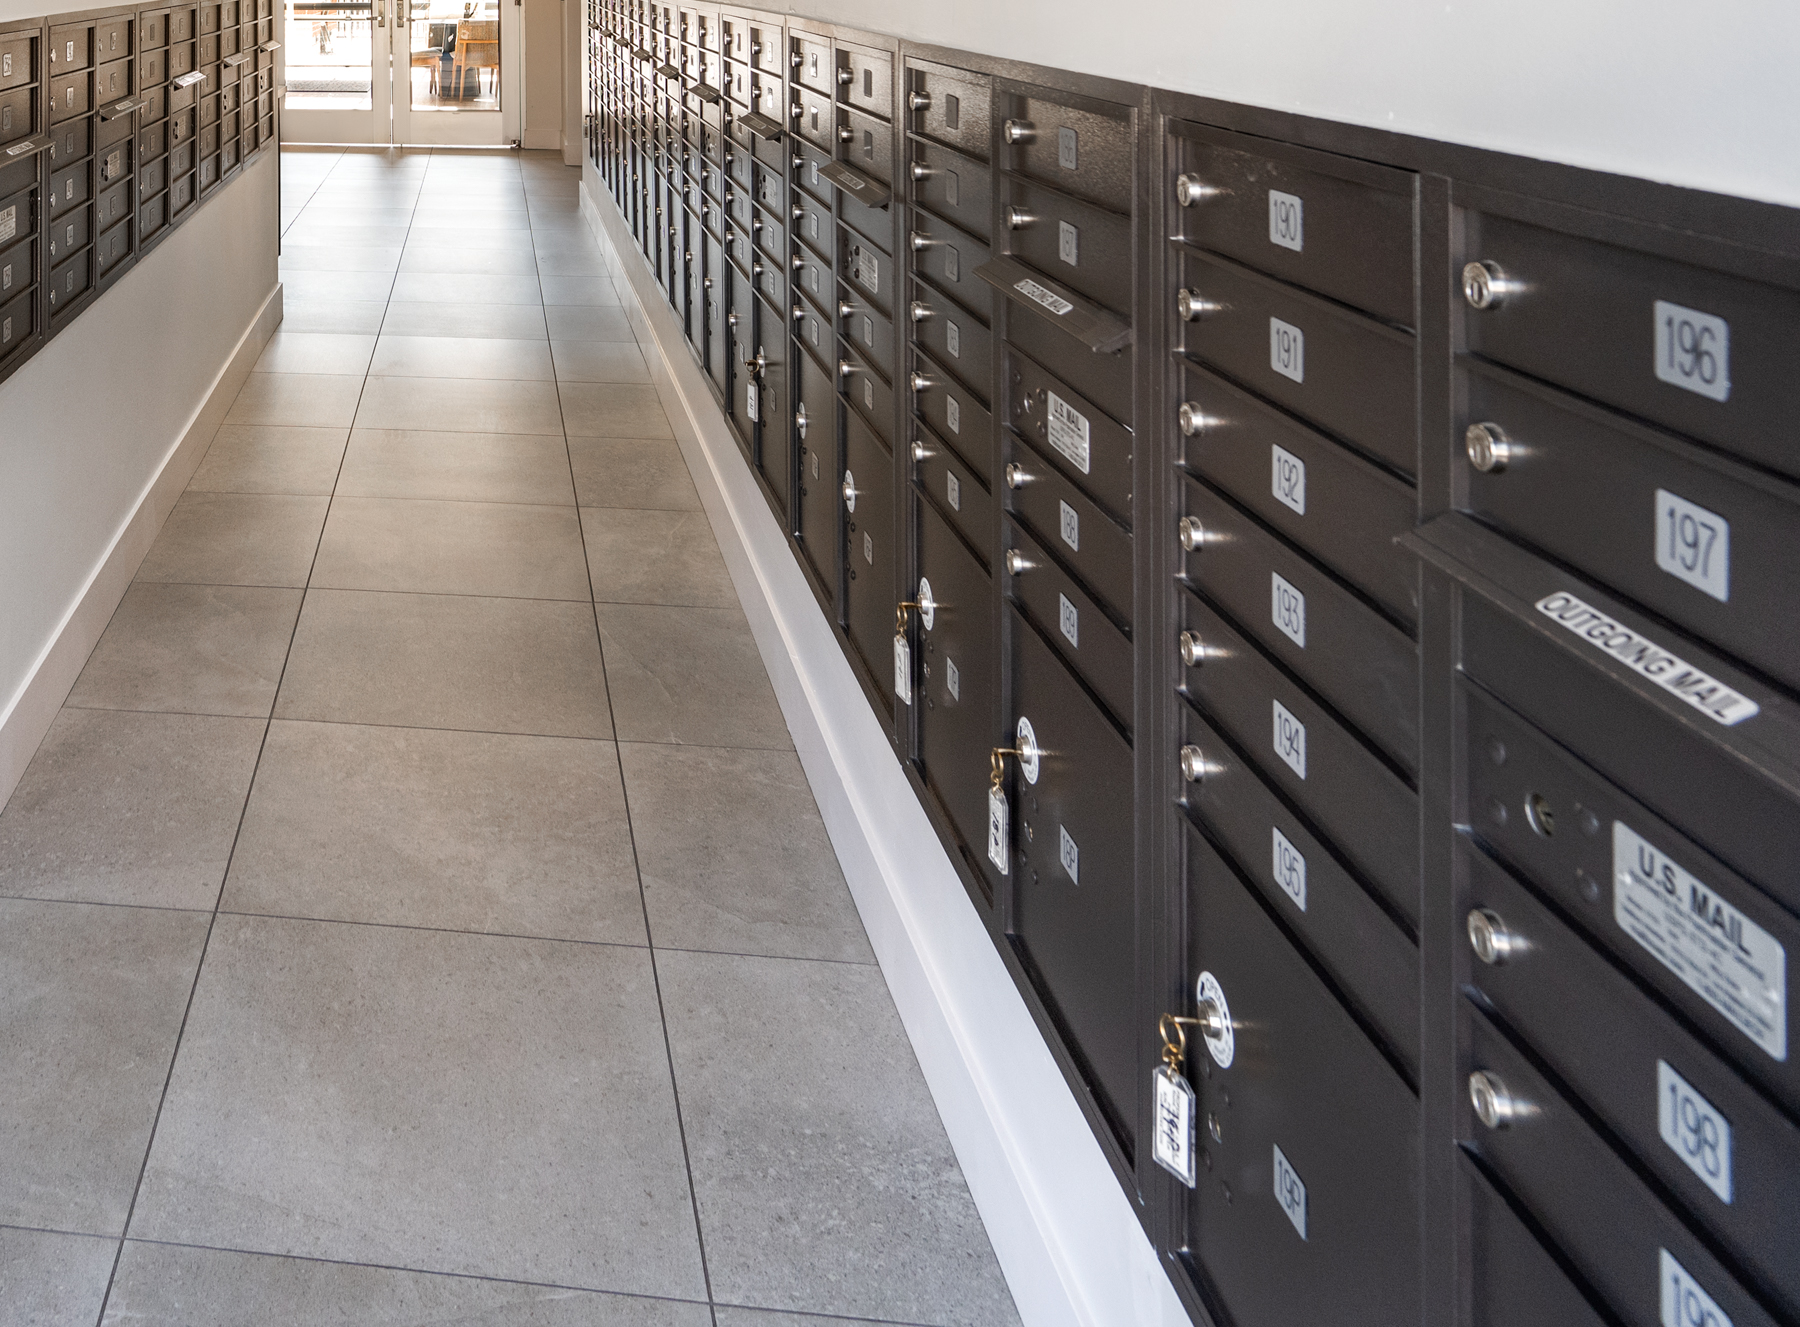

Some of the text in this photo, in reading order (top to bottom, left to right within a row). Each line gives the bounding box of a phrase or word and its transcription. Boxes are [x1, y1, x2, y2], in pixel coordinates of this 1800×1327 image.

[1272, 199, 1298, 242] 190
[1275, 325, 1299, 372] 191
[1665, 315, 1717, 386] 196
[1277, 454, 1300, 504] 192
[1062, 507, 1076, 545] 188
[1666, 507, 1718, 580] 197
[1062, 601, 1075, 639] 189
[1276, 583, 1299, 636] 193
[1543, 595, 1741, 719] OUTGOING MAIL
[1277, 711, 1301, 766] 194
[1277, 840, 1301, 898] 195
[1638, 843, 1752, 957] U.S. MAIL
[1669, 1082, 1721, 1179] 198
[1277, 1158, 1301, 1217] 19P
[1671, 1273, 1721, 1327] 19
